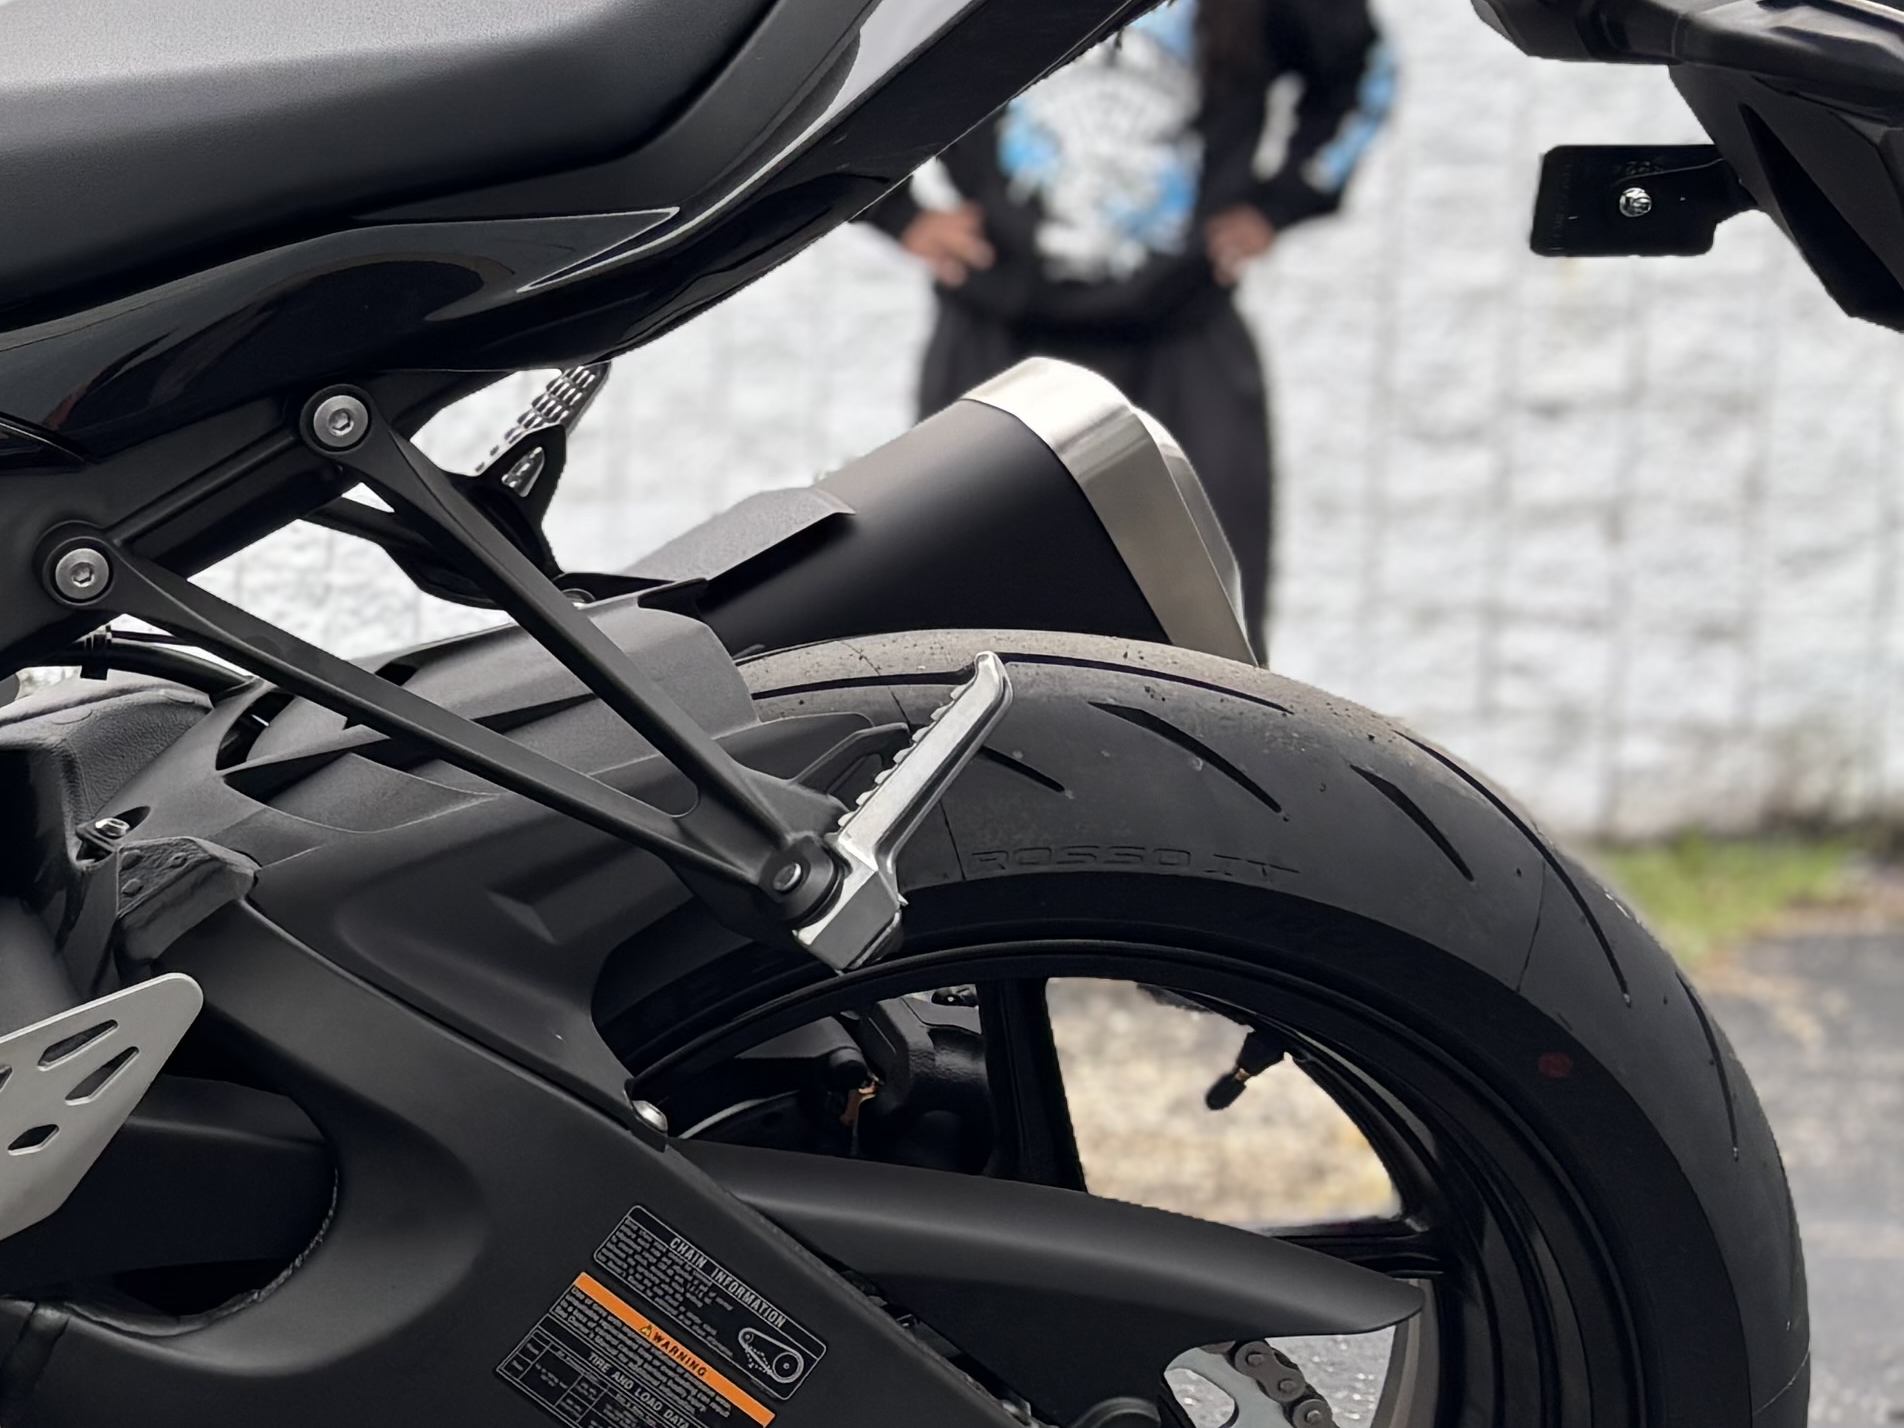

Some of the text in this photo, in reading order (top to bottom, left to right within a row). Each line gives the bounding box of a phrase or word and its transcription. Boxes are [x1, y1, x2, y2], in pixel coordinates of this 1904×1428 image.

[669, 1236, 788, 1329] CHAIN INFORMATION
[587, 1353, 611, 1373] TIRE
[612, 1370, 635, 1390] AND
[635, 1388, 662, 1411] LOAD
[652, 1332, 708, 1378] WARNING
